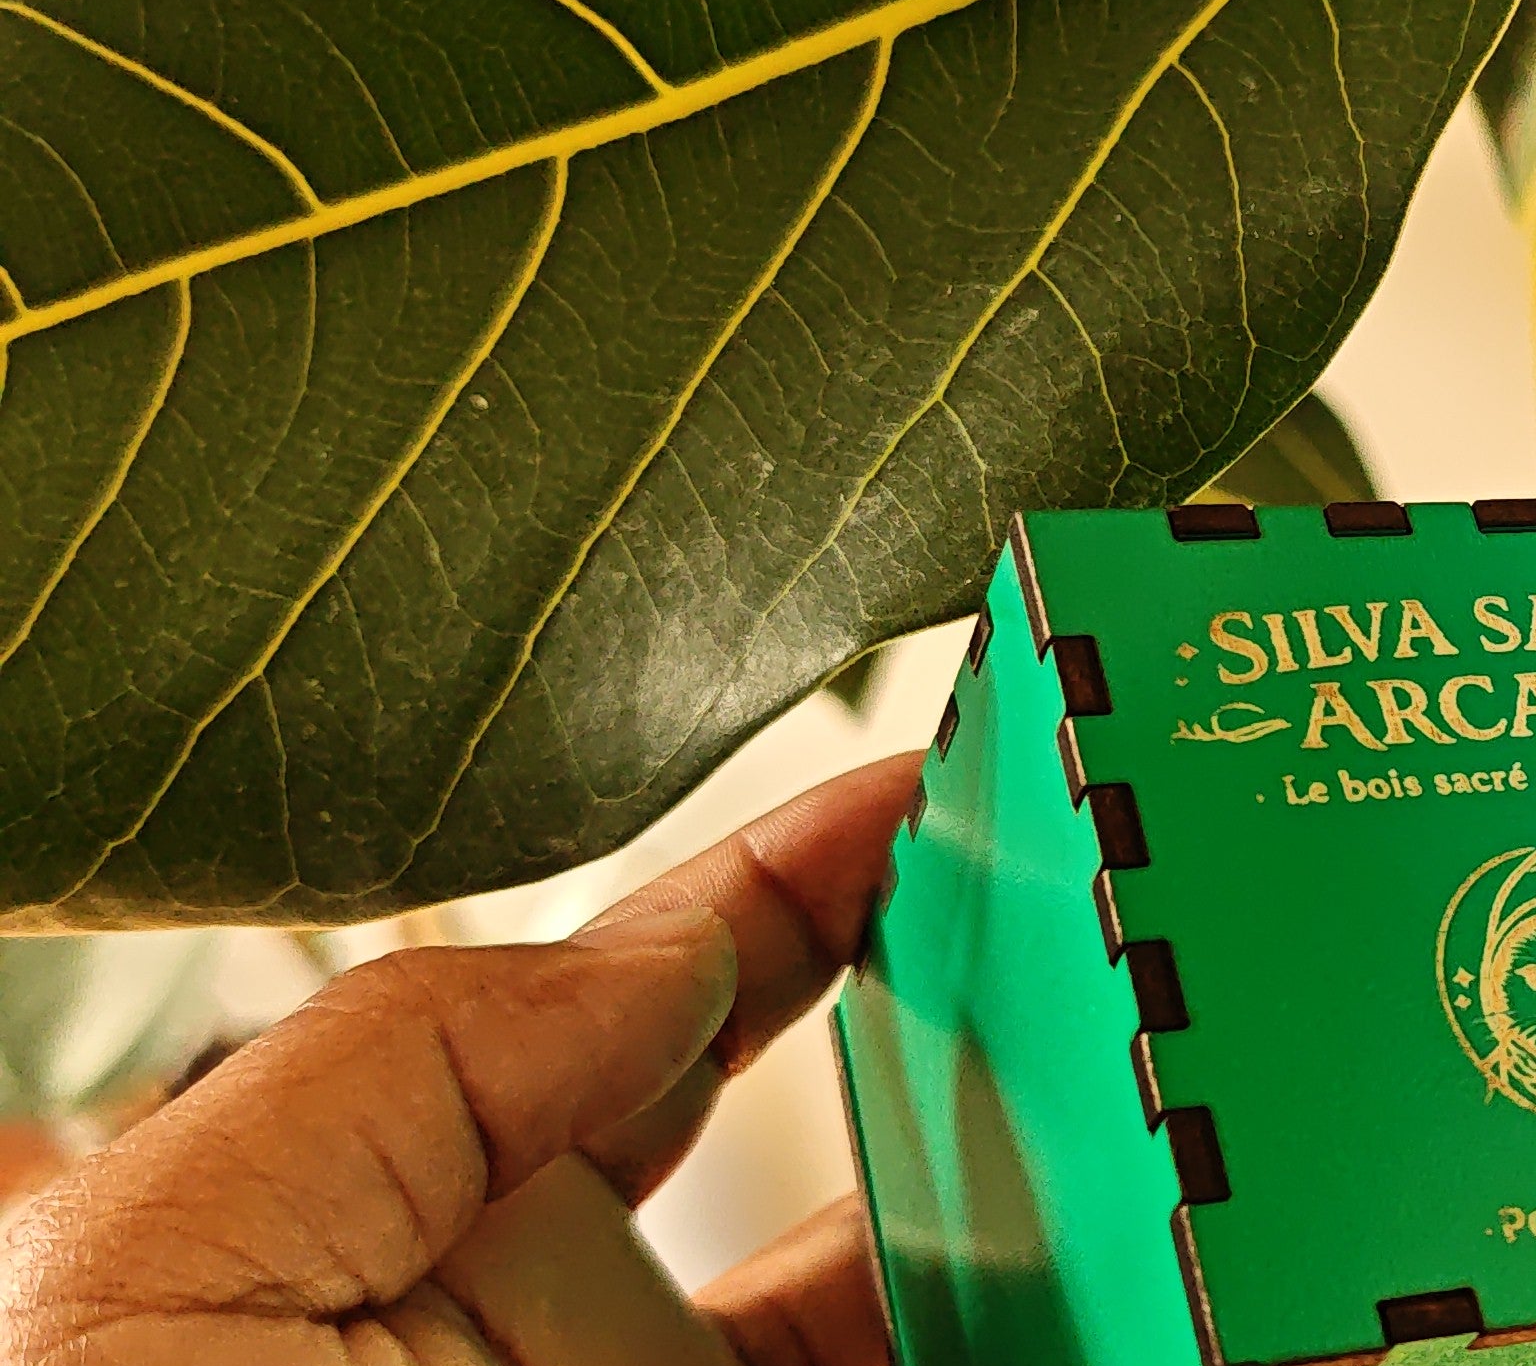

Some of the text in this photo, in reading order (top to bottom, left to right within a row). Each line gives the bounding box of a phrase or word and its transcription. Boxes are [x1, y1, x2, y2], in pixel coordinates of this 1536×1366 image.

[1209, 598, 1461, 685] SILVA
[1282, 773, 1331, 806] Le
[1337, 768, 1423, 803] bois
[1434, 761, 1528, 796] sacré
